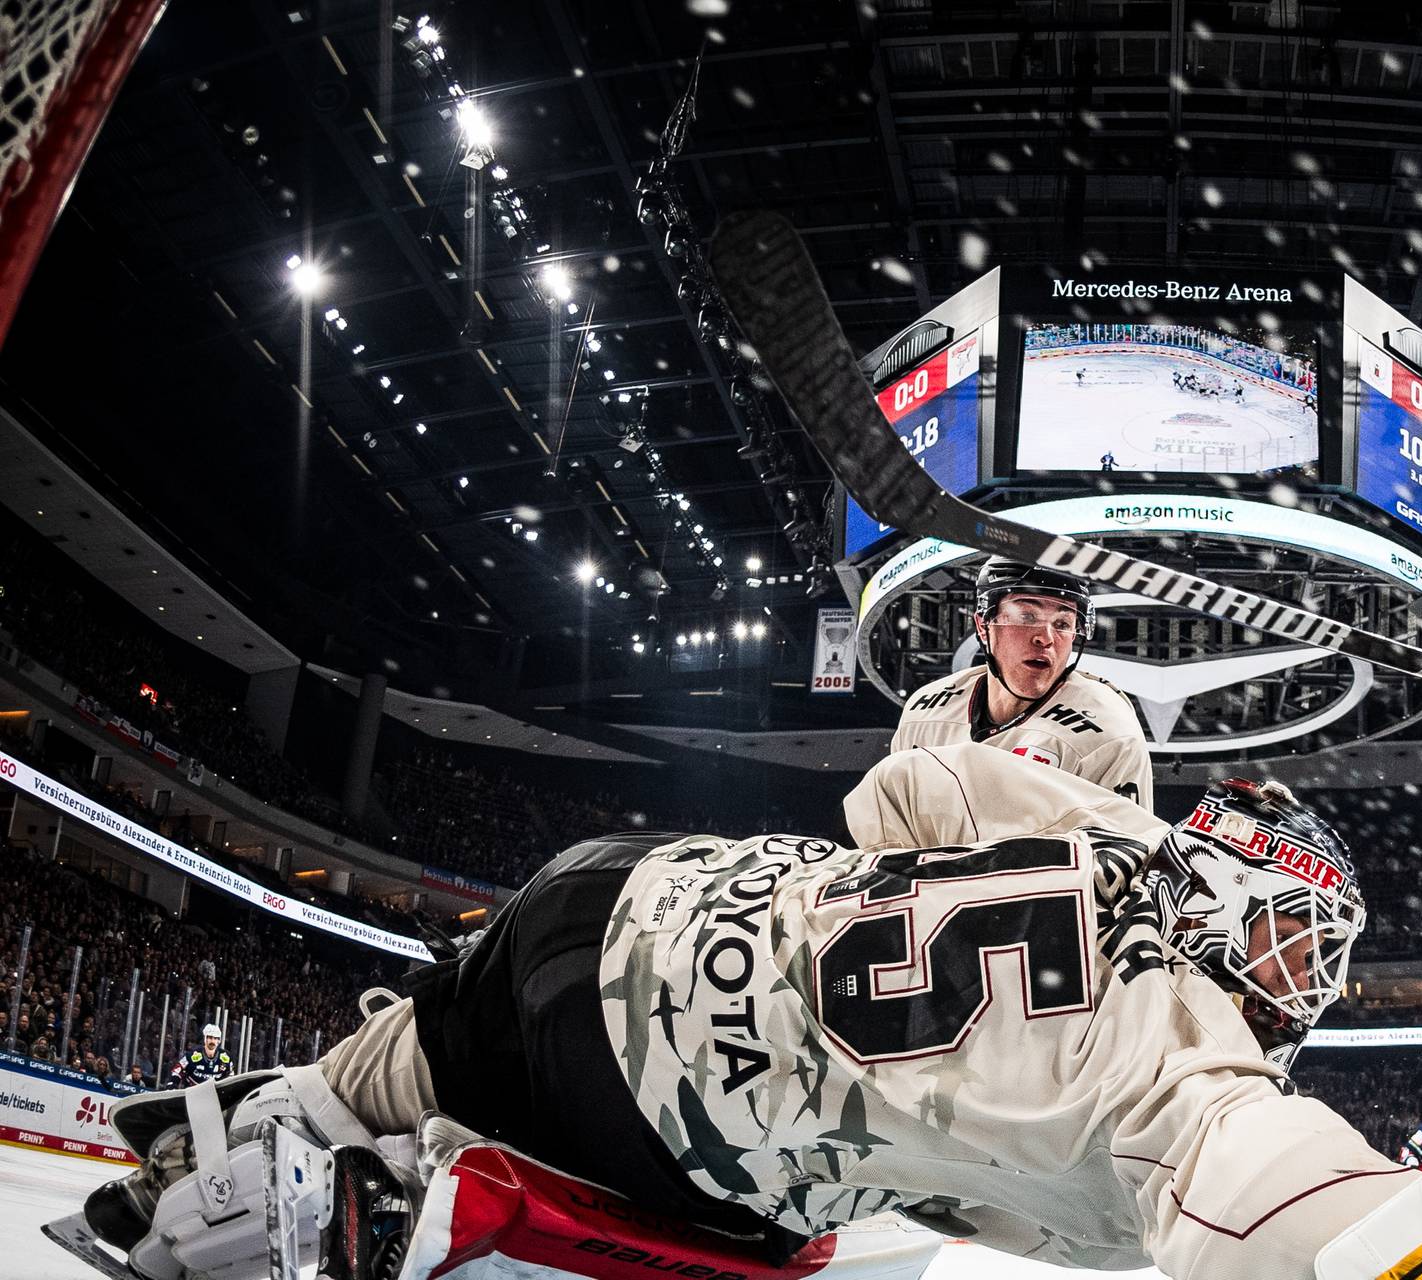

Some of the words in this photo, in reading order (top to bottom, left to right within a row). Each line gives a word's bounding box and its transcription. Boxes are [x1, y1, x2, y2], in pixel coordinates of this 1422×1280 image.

[1052, 279, 1220, 300] Mercedes-Benz
[1225, 283, 1292, 302] Arena
[893, 368, 929, 411] 0:0
[1104, 505, 1173, 519] amazon
[1177, 506, 1234, 522] music
[1035, 536, 1352, 652] WARRIOR
[814, 676, 851, 688] 2005
[910, 683, 965, 712] HIT
[1041, 703, 1104, 735] HIT
[33, 776, 121, 831] Versicherungsbüro
[122, 824, 166, 855] Alexander
[166, 846, 173, 857] &
[174, 850, 232, 887] Ernst-Heinrich
[233, 878, 252, 896] Hoth
[263, 892, 286, 911] ERGO
[302, 907, 382, 943] Versicherungsbüro
